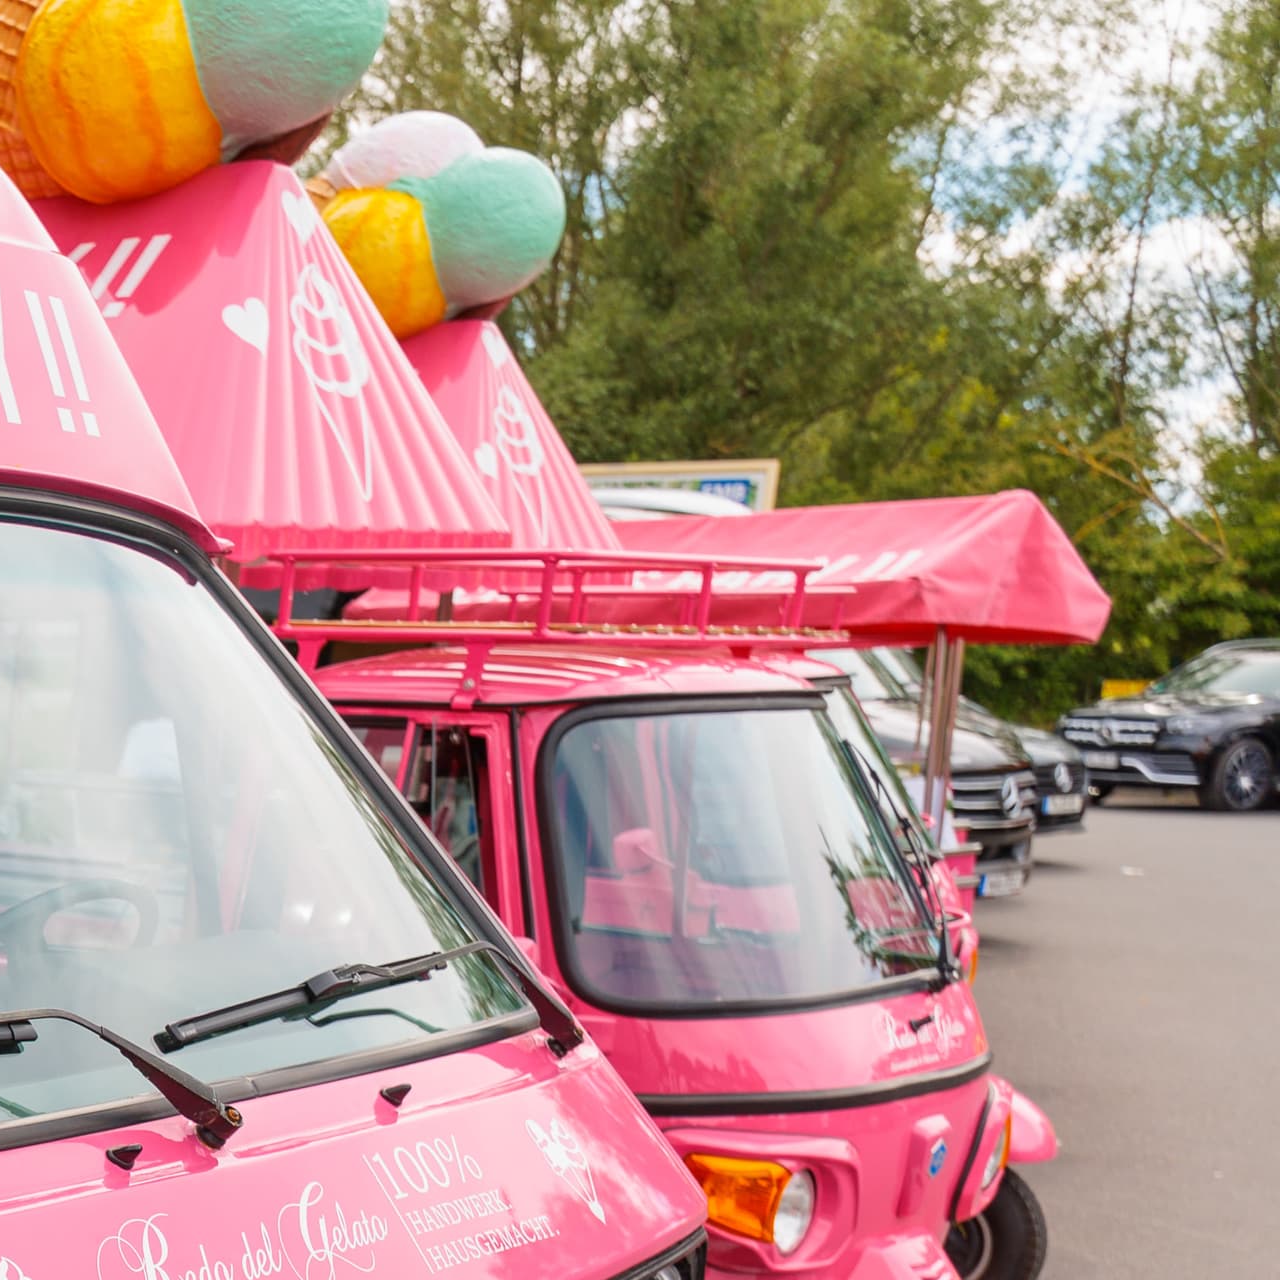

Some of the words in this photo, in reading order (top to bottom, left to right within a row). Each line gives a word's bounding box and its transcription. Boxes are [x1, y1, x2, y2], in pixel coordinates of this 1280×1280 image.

[372, 1134, 483, 1200] 100%
[406, 1189, 513, 1235] HANDWERK.
[241, 1224, 282, 1280] del
[425, 1216, 561, 1271] HAUSGEMACHT.
